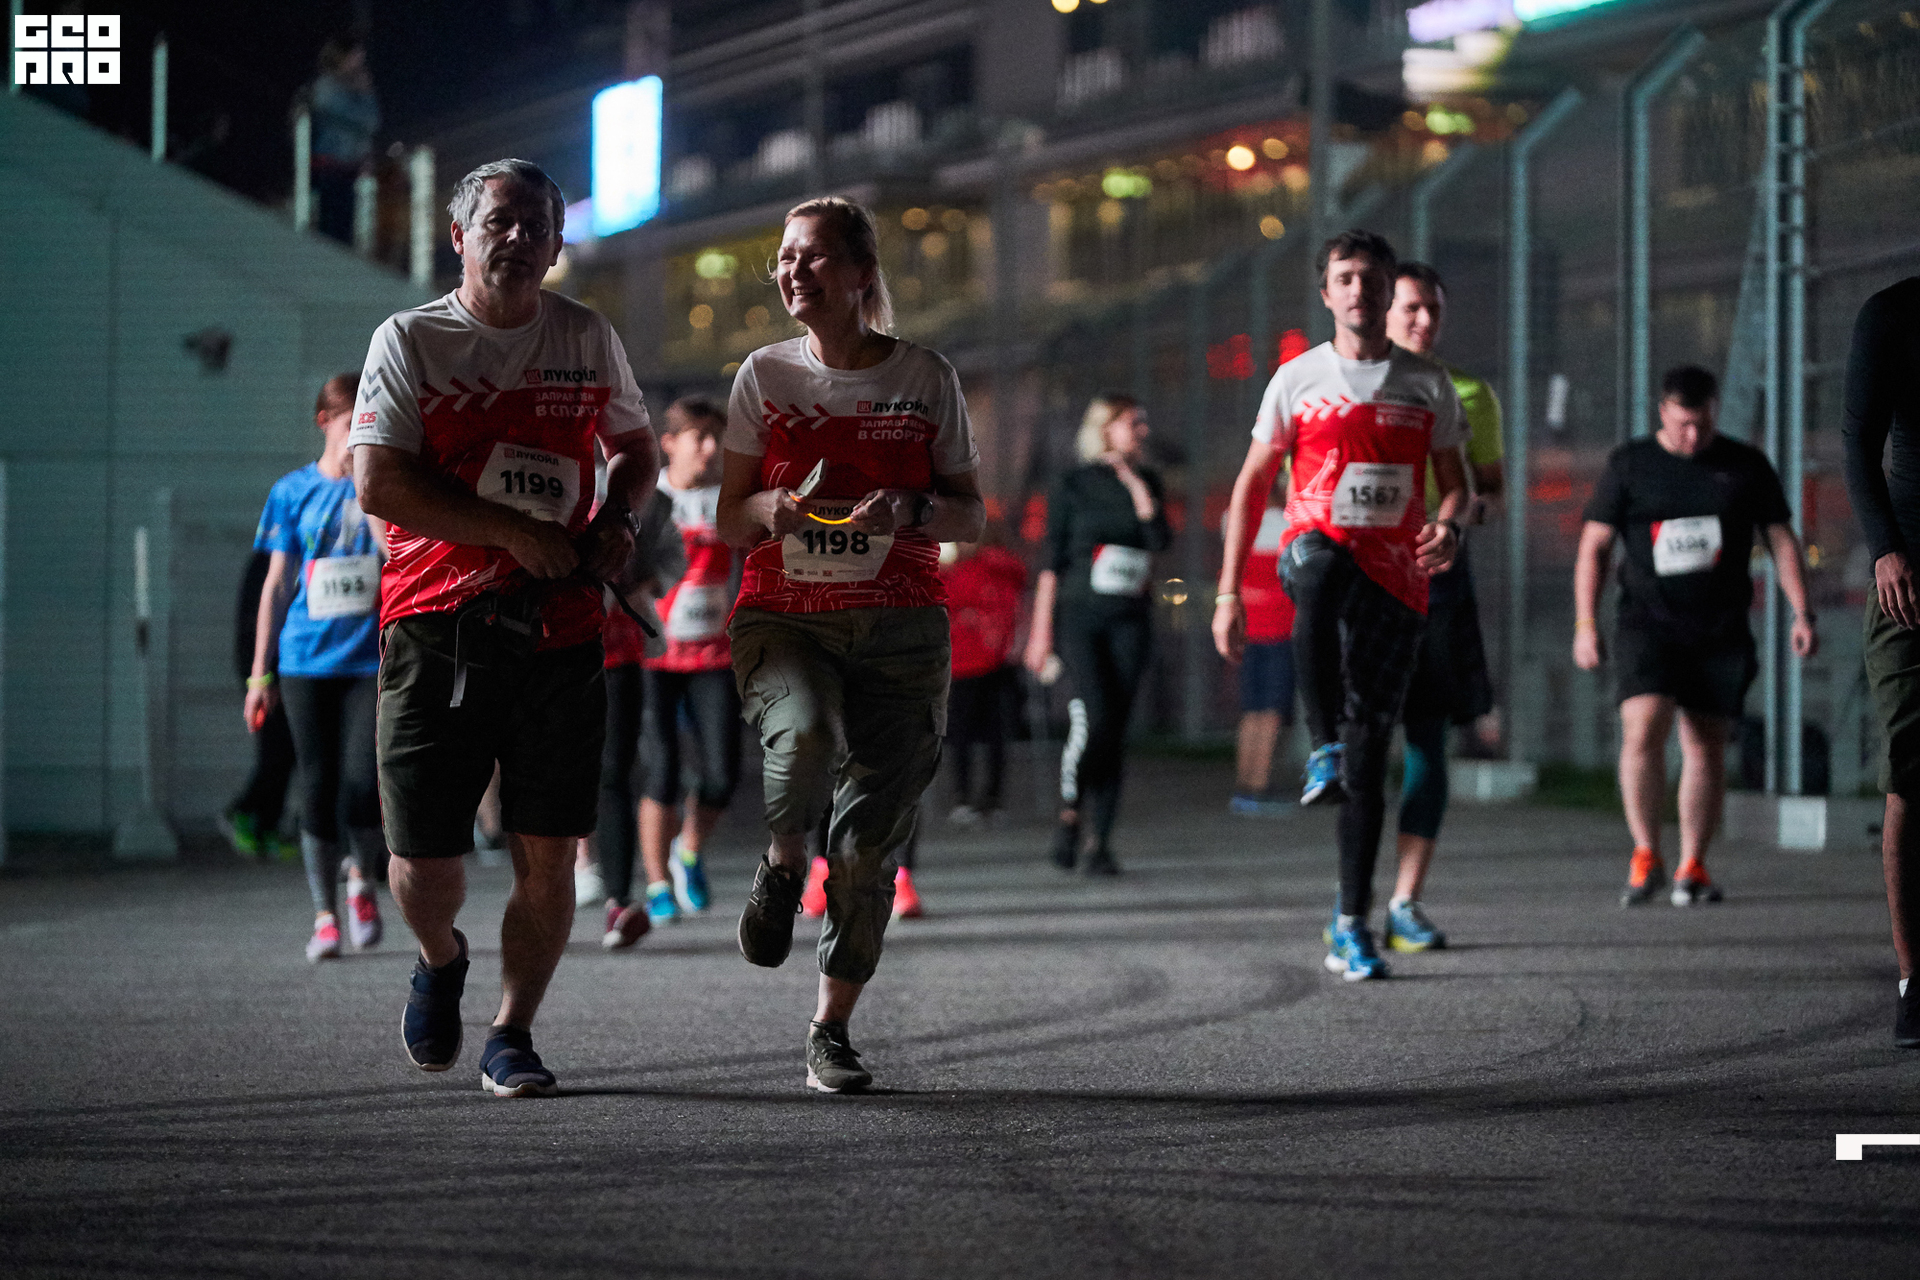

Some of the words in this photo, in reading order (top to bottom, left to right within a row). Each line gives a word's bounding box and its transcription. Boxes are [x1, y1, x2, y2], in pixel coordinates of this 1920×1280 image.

[535, 404, 547, 417] В
[872, 399, 929, 417] ЛУКОЙЛ
[857, 430, 868, 440] В
[516, 448, 559, 466] ЛУКОЙЛ
[500, 470, 564, 498] 1199
[1349, 485, 1401, 506] 1567
[803, 530, 870, 554] 1198
